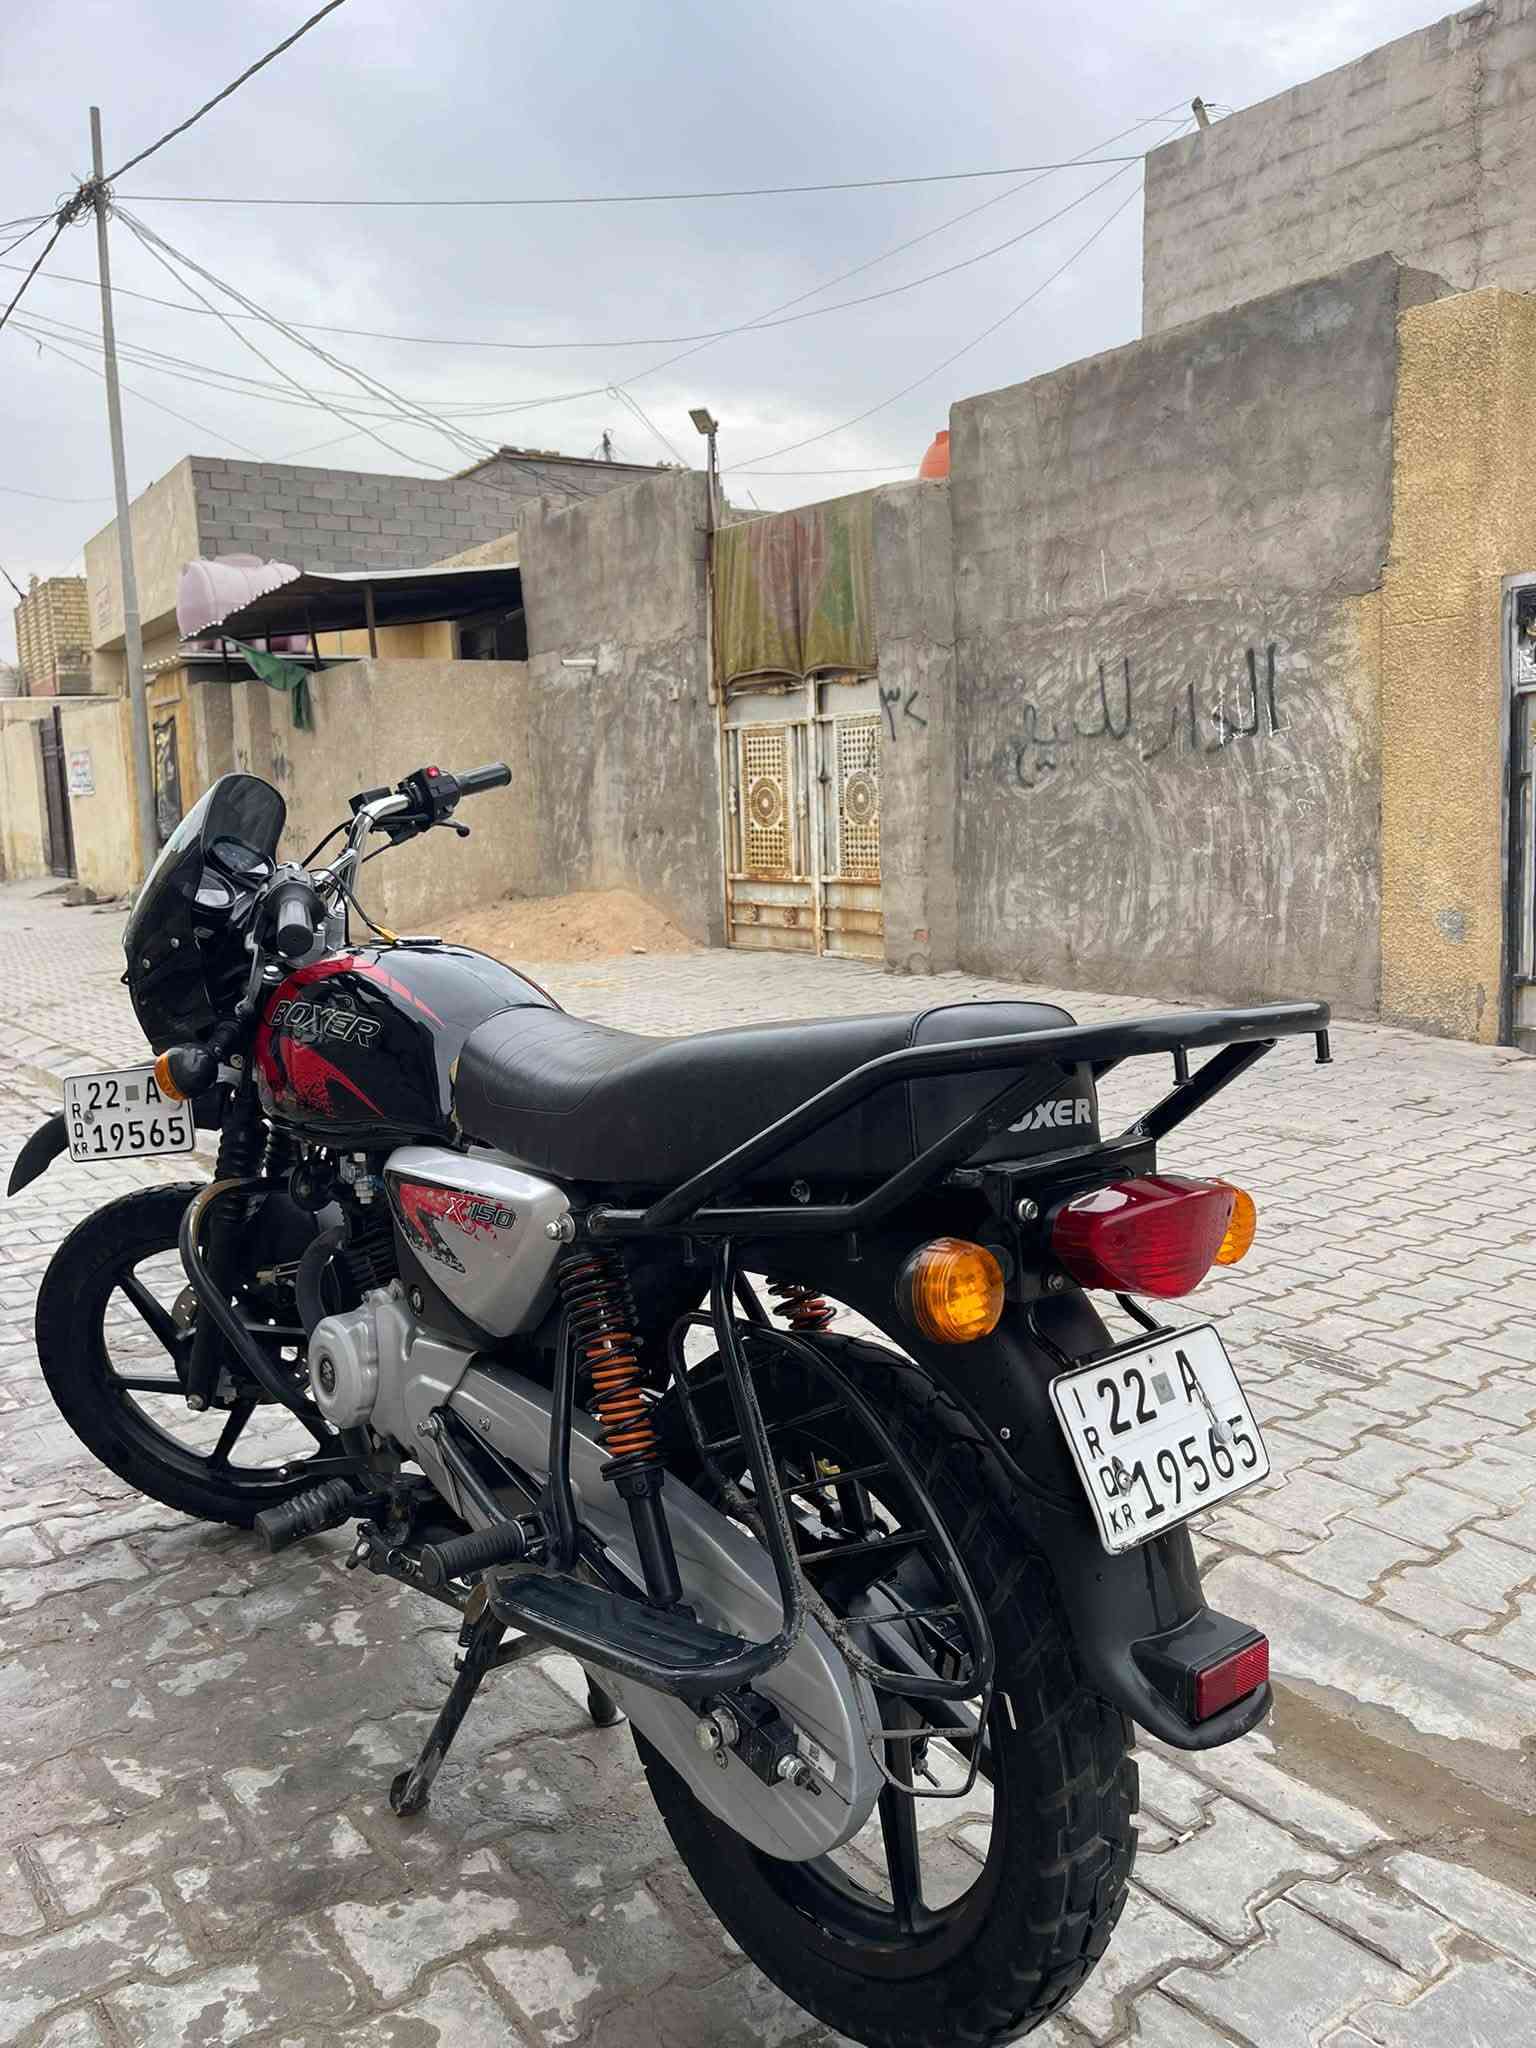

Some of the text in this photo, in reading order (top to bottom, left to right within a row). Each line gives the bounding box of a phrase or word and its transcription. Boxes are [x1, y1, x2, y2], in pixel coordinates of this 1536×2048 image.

[270, 1000, 382, 1048] BOXER
[87, 1076, 162, 1110] 22 A
[1007, 1098, 1092, 1132] XER
[72, 1141, 88, 1155] KR
[92, 1116, 186, 1153] 19565
[1096, 1349, 1210, 1436] 22 A
[1131, 1415, 1258, 1519] 19565
[1109, 1503, 1136, 1534] KR
